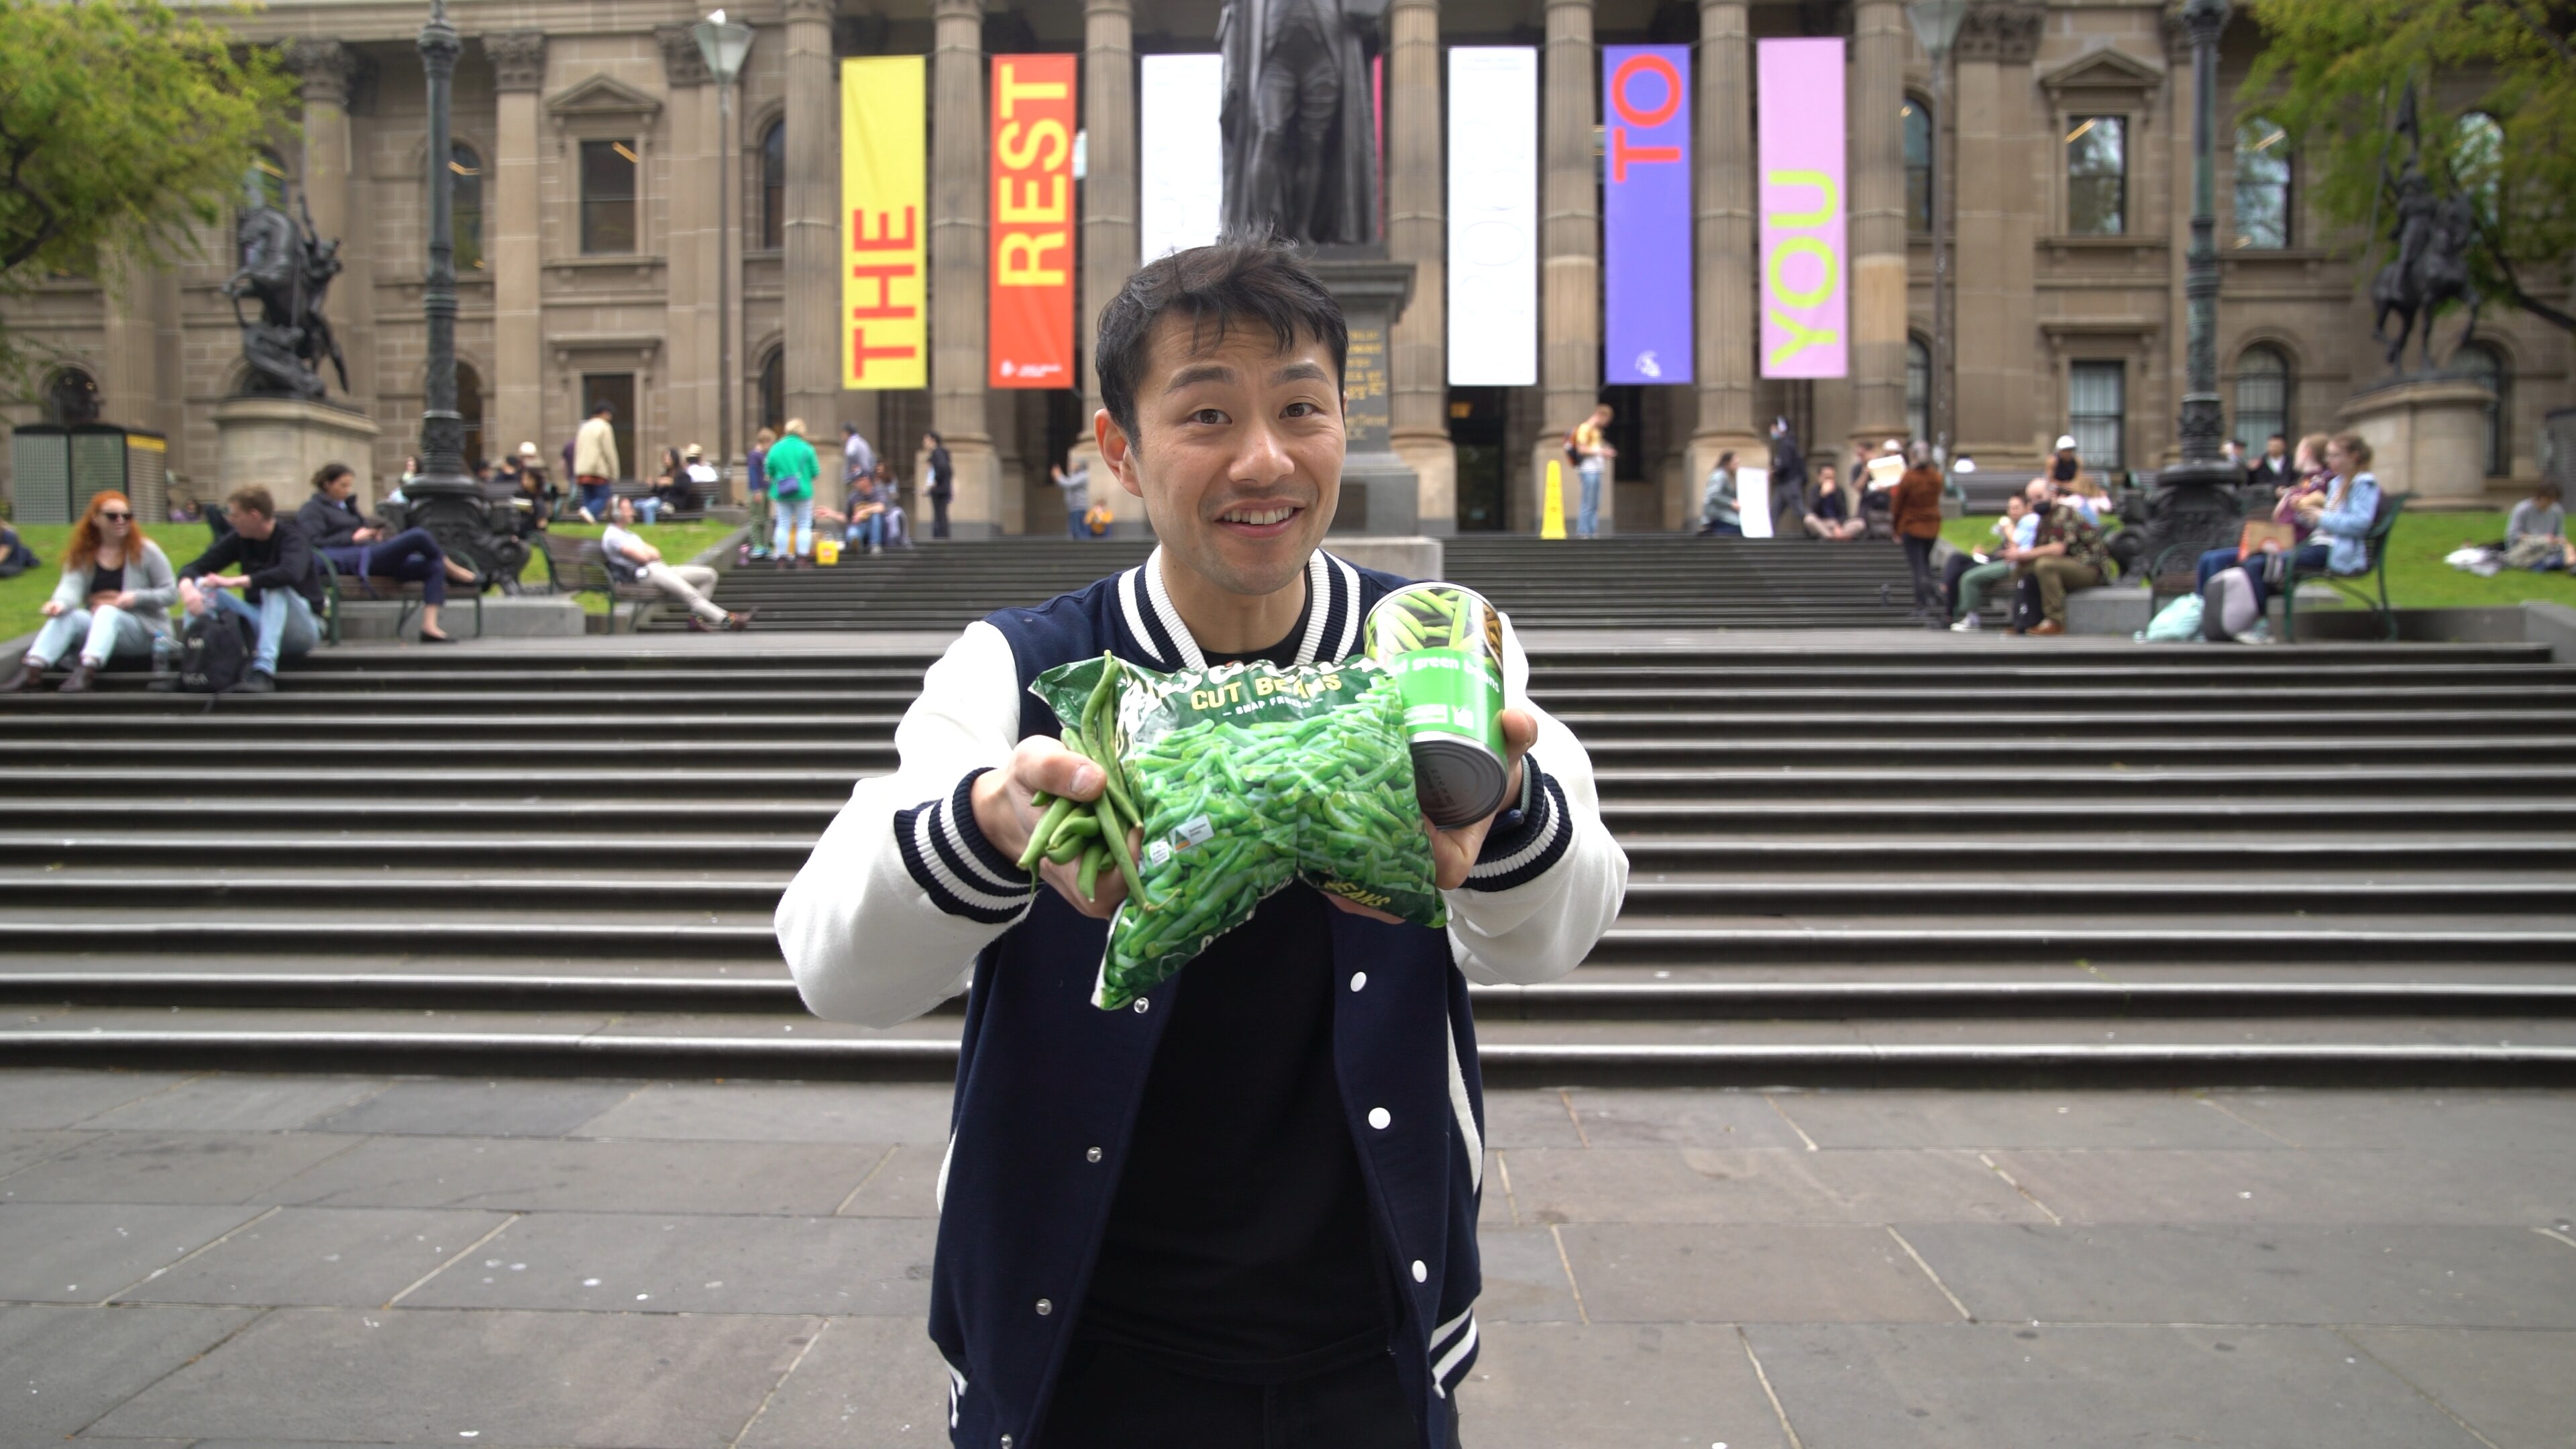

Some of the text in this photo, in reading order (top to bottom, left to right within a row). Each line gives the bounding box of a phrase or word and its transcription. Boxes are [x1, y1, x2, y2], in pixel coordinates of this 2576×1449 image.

[998, 63, 1069, 286] REST
[1611, 54, 1682, 182] TO
[853, 206, 916, 379] THE
[1768, 169, 1837, 366] YOU
[1191, 682, 1242, 710] CUT
[1236, 700, 1265, 714] SNAP
[1412, 657, 1460, 672] green
